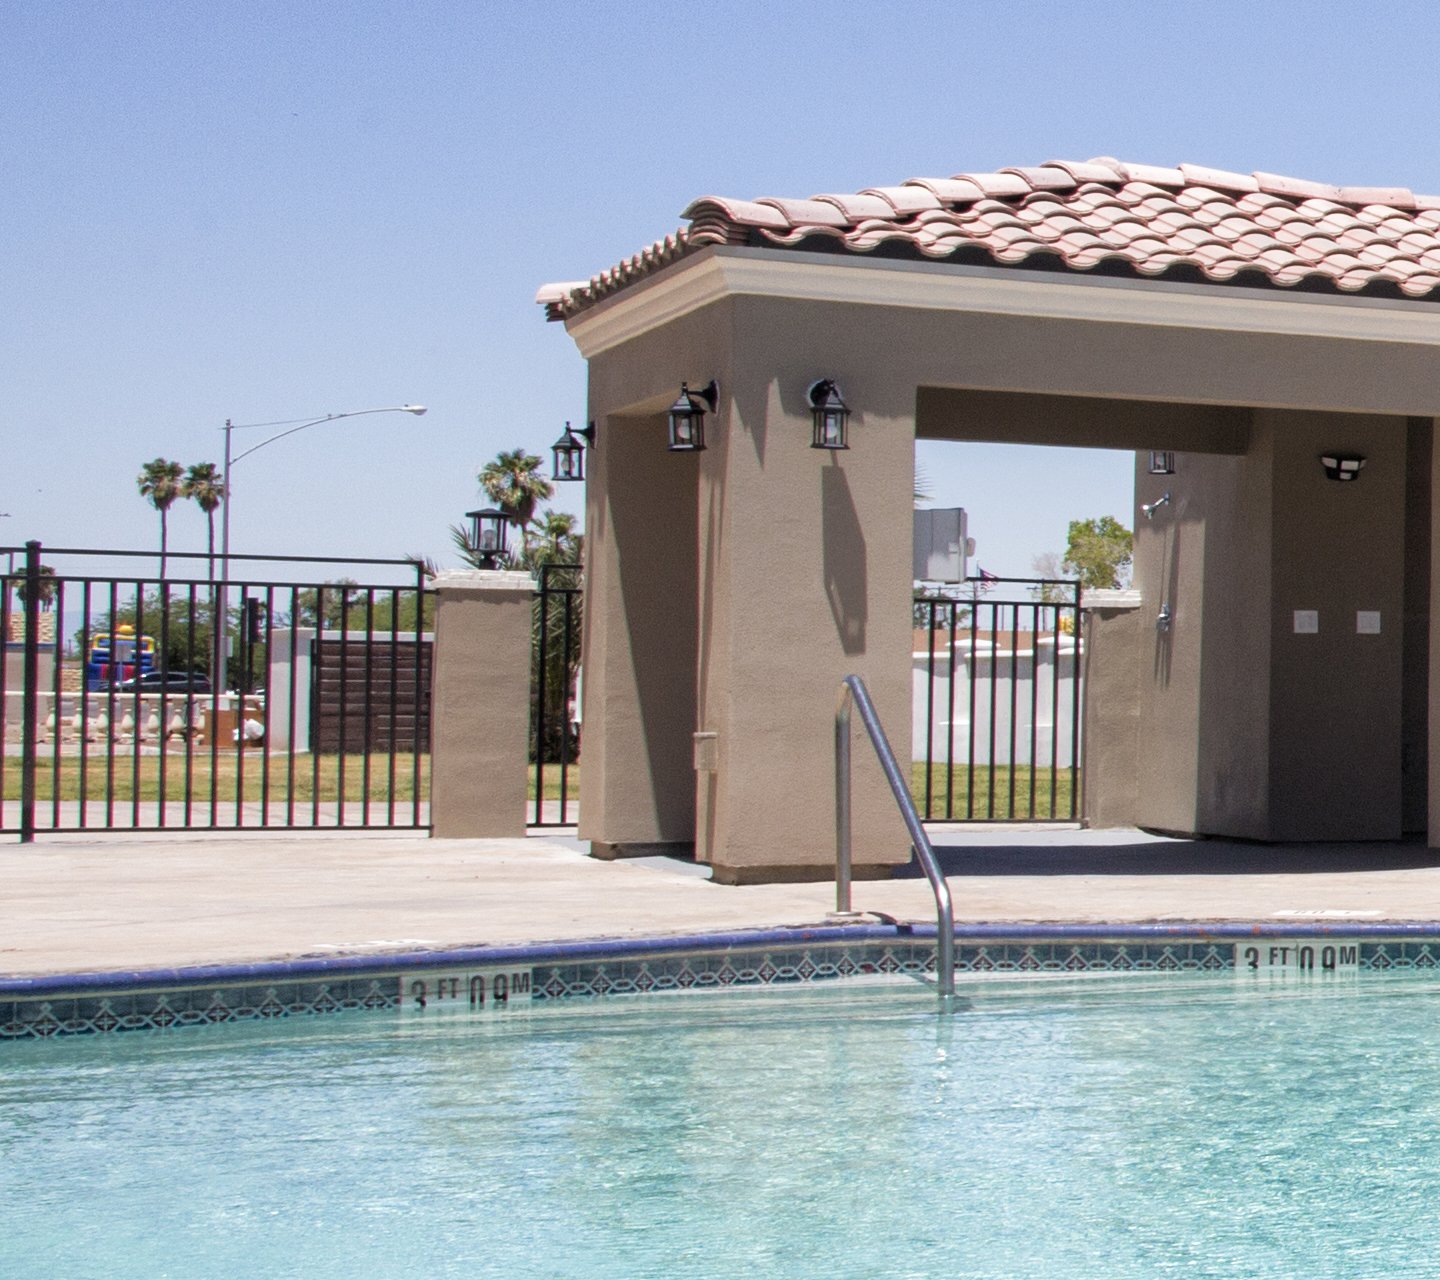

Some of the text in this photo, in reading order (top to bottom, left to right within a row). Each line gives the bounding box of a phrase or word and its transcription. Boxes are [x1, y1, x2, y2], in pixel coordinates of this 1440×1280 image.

[1245, 947, 1259, 969] 3
[1269, 947, 1289, 965] FT
[411, 981, 427, 1006] 3
[438, 978, 459, 999] FT
